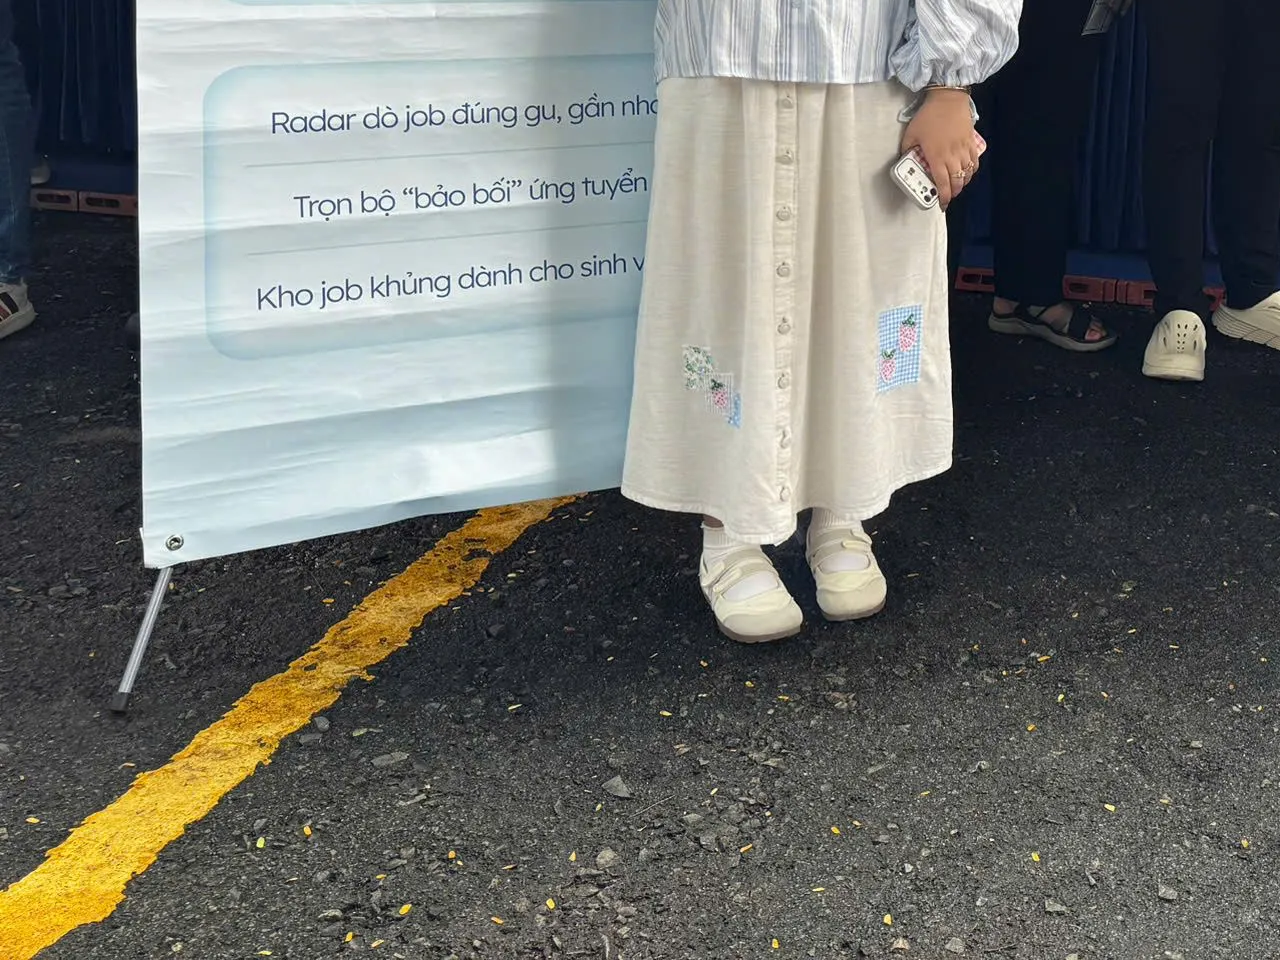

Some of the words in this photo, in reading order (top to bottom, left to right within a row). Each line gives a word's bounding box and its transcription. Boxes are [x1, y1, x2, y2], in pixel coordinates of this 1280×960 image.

[271, 110, 356, 134] Radar
[362, 105, 398, 130] dò
[404, 102, 445, 133] job
[452, 100, 517, 129] đúng
[524, 104, 562, 127] gu,
[568, 92, 614, 125] gần
[294, 194, 352, 221] Trọn
[361, 189, 395, 217] bộ
[403, 184, 465, 209] “bảo
[472, 178, 521, 205] bối”
[529, 178, 575, 204] ứng
[582, 167, 647, 198] tuyển
[257, 283, 313, 311] Kho
[320, 279, 362, 309] job
[370, 271, 451, 300] khủng
[458, 265, 522, 290] dành
[529, 260, 573, 283] cho
[580, 253, 626, 277] sinh
